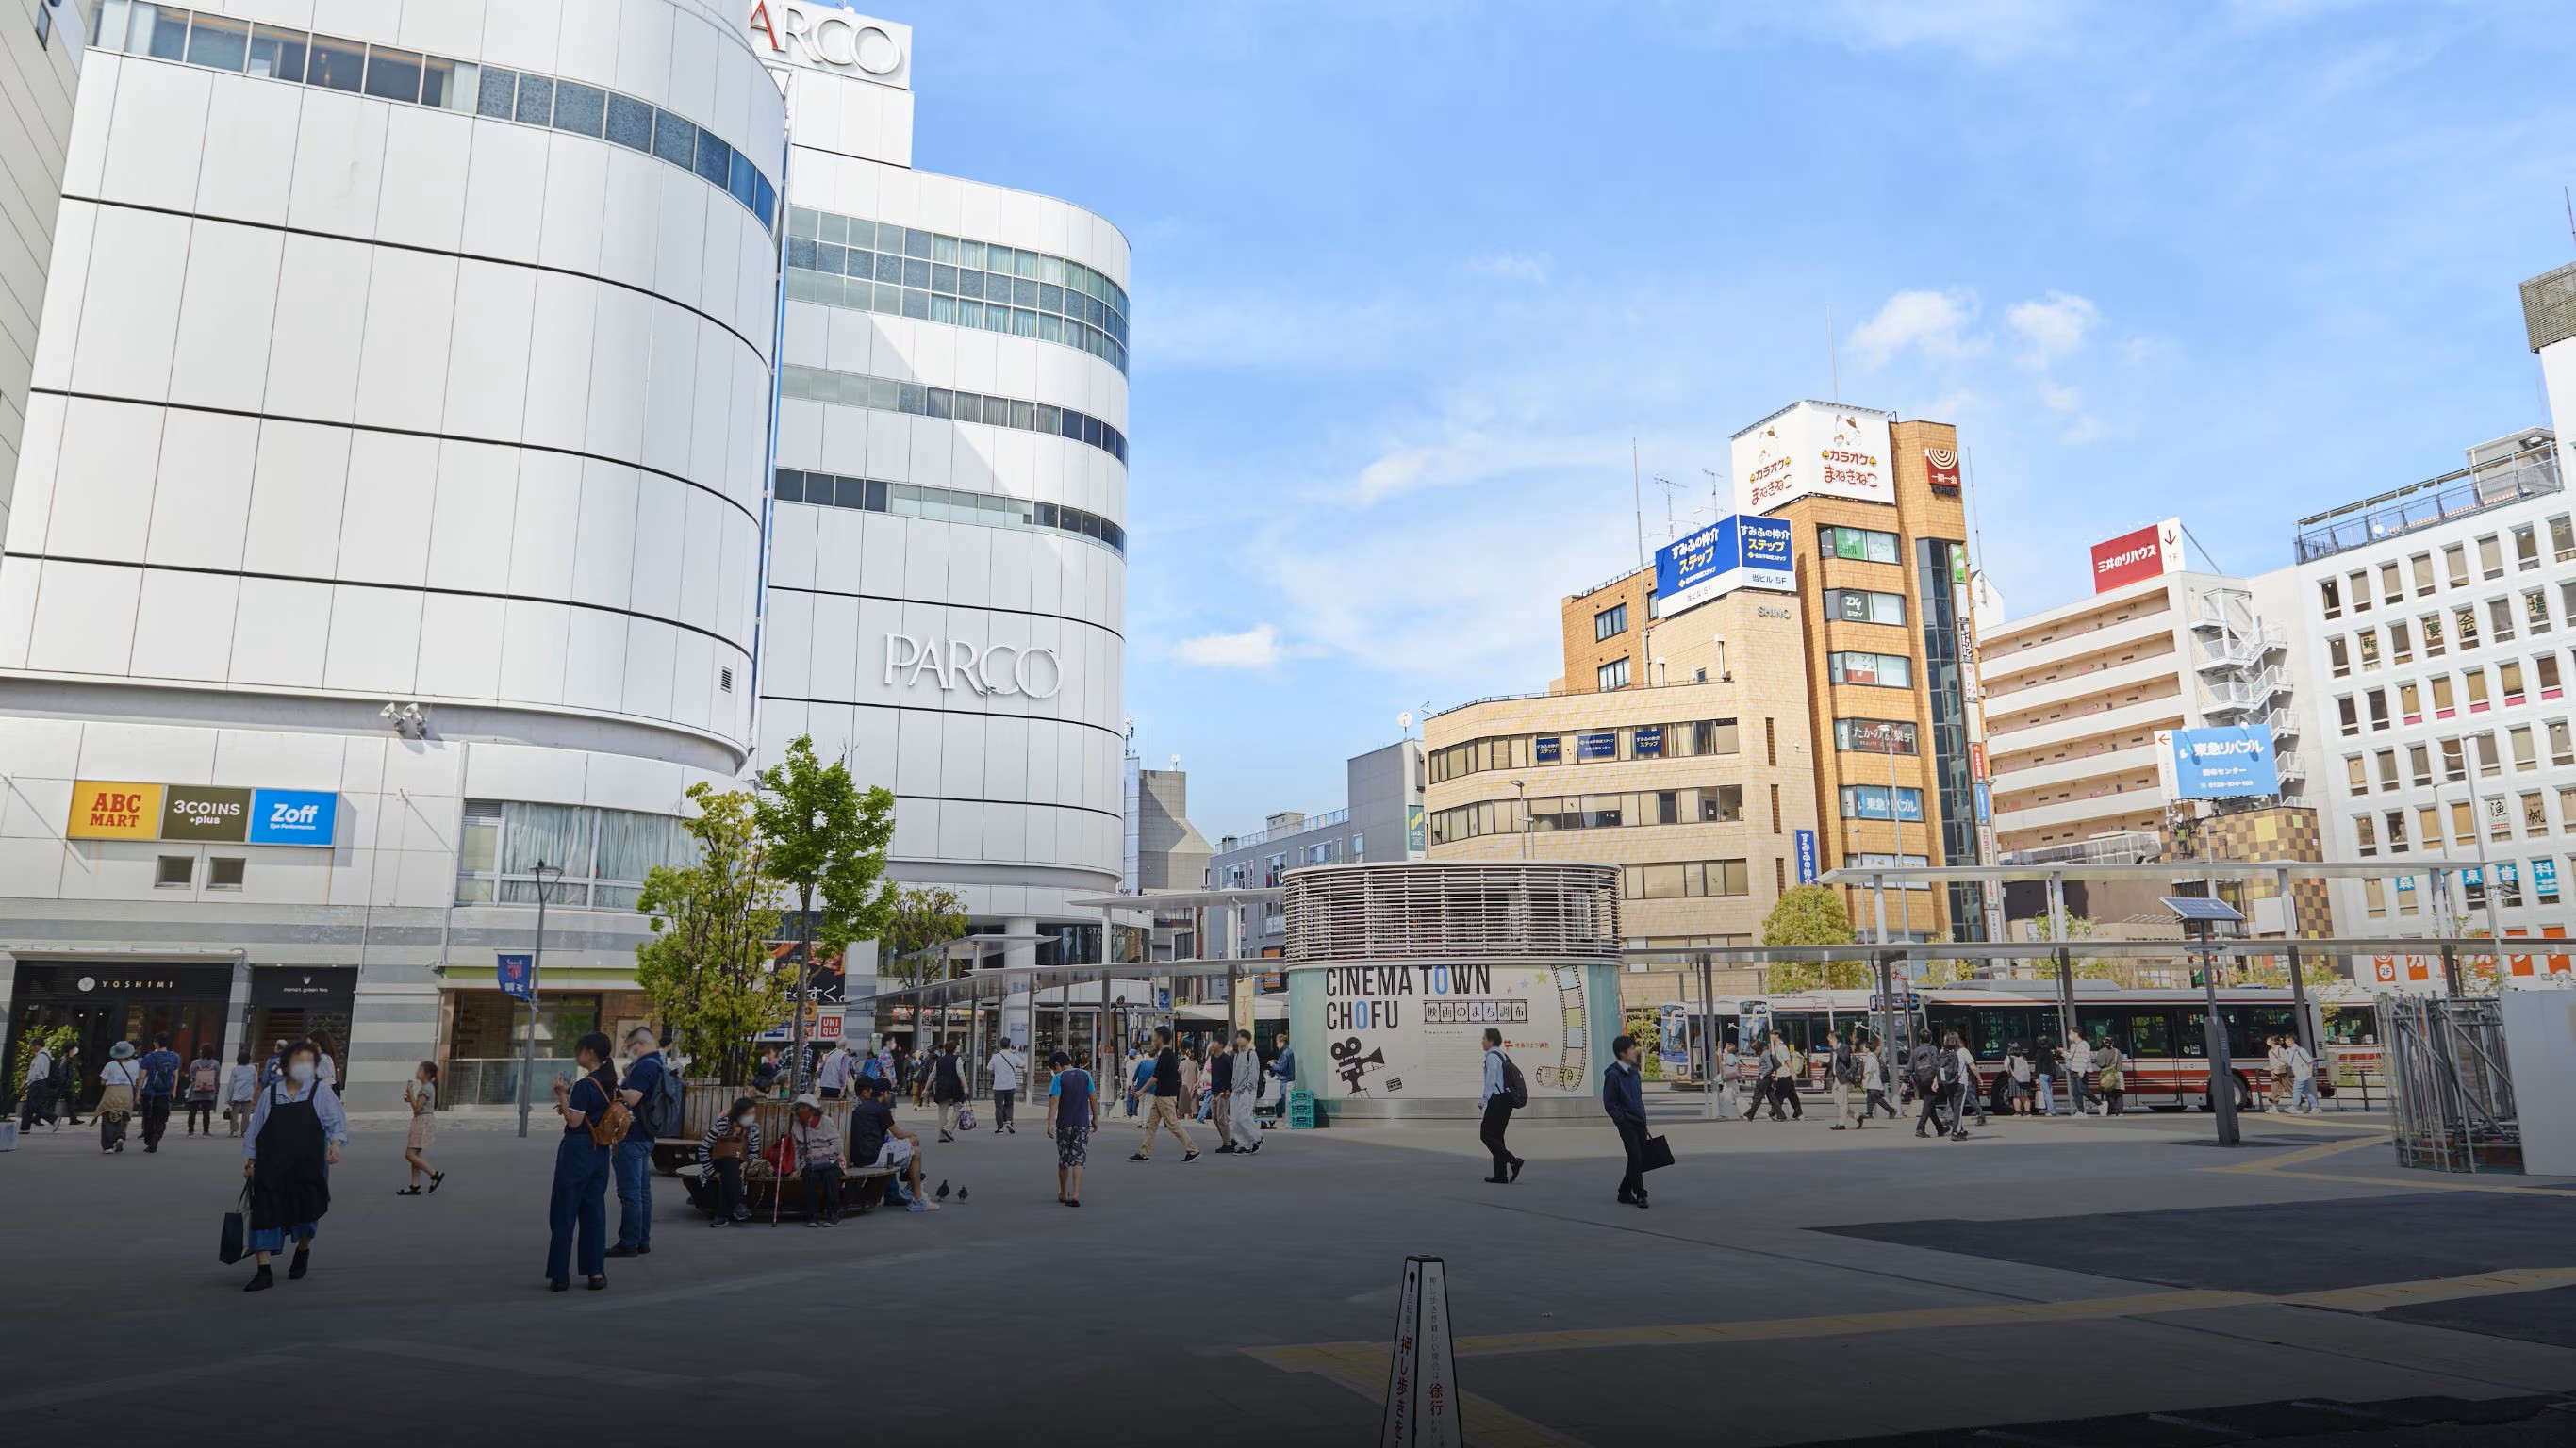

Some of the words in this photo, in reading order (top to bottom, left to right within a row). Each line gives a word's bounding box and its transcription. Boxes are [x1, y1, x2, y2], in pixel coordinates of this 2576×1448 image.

[751, 0, 901, 74] ARCO
[1829, 451, 1869, 465] カラオケ
[1755, 459, 1785, 480] カラオケ
[1824, 466, 1878, 487] まねきねこ
[1751, 474, 1792, 505] まねきねこ
[1741, 525, 1791, 540] すみふの仲介
[1672, 528, 1719, 559] すみふの仲介
[1748, 538, 1785, 552] ステップ
[1679, 546, 1715, 574] ステップ
[2097, 544, 2157, 573] 三井のリハウス
[1752, 573, 1773, 583] 当ビル
[1758, 606, 1792, 619] SHINO
[1846, 596, 1862, 611] ZXY
[883, 633, 1065, 699] PARCO
[2193, 740, 2265, 757] 東急リバブル
[91, 793, 141, 813] ABC
[173, 799, 240, 815] 3COINS
[2490, 800, 2507, 817] 漁
[90, 813, 140, 828] MART
[271, 803, 319, 823] Zoff
[1801, 833, 1813, 885] すみふの仲介
[1087, 927, 1135, 937] STAUCKS
[1326, 965, 1412, 996] CINEMA
[1418, 964, 1491, 995] TOWN
[1326, 1000, 1398, 1029] CHOFU
[1428, 1005, 1524, 1018] 映画のまち調布
[822, 1028, 839, 1036] QLO
